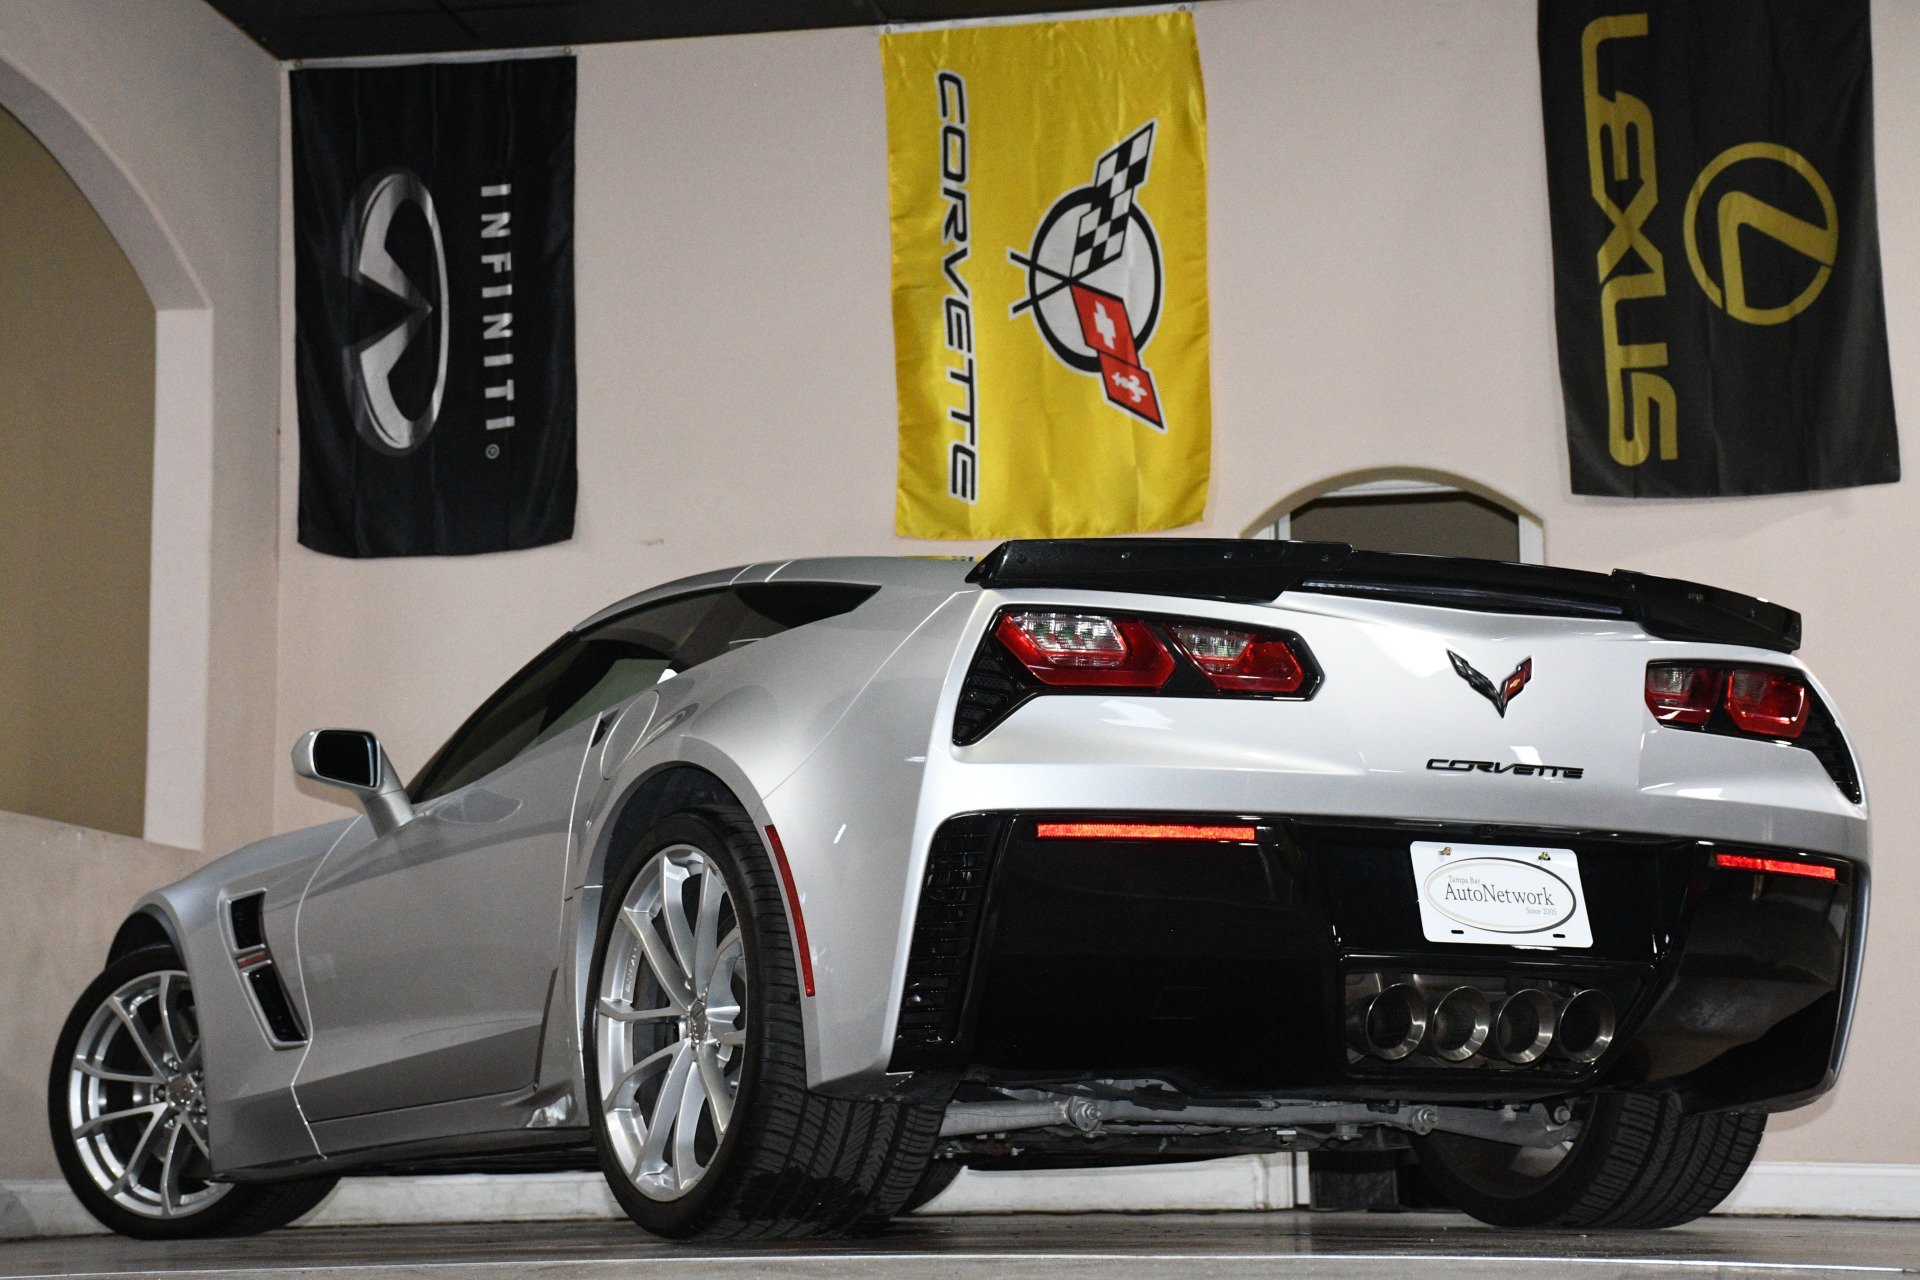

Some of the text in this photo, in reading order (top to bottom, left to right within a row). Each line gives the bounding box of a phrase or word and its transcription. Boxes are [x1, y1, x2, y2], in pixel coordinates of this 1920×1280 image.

[1581, 13, 1678, 467] LEXUS
[936, 69, 979, 503] CORVETTE
[480, 183, 516, 431] INFINITI
[1426, 758, 1584, 779] CORVETTE
[1448, 875, 1481, 885] Tampa Bay
[1445, 882, 1554, 906] AutoNetwork
[1525, 906, 1541, 915] Since
